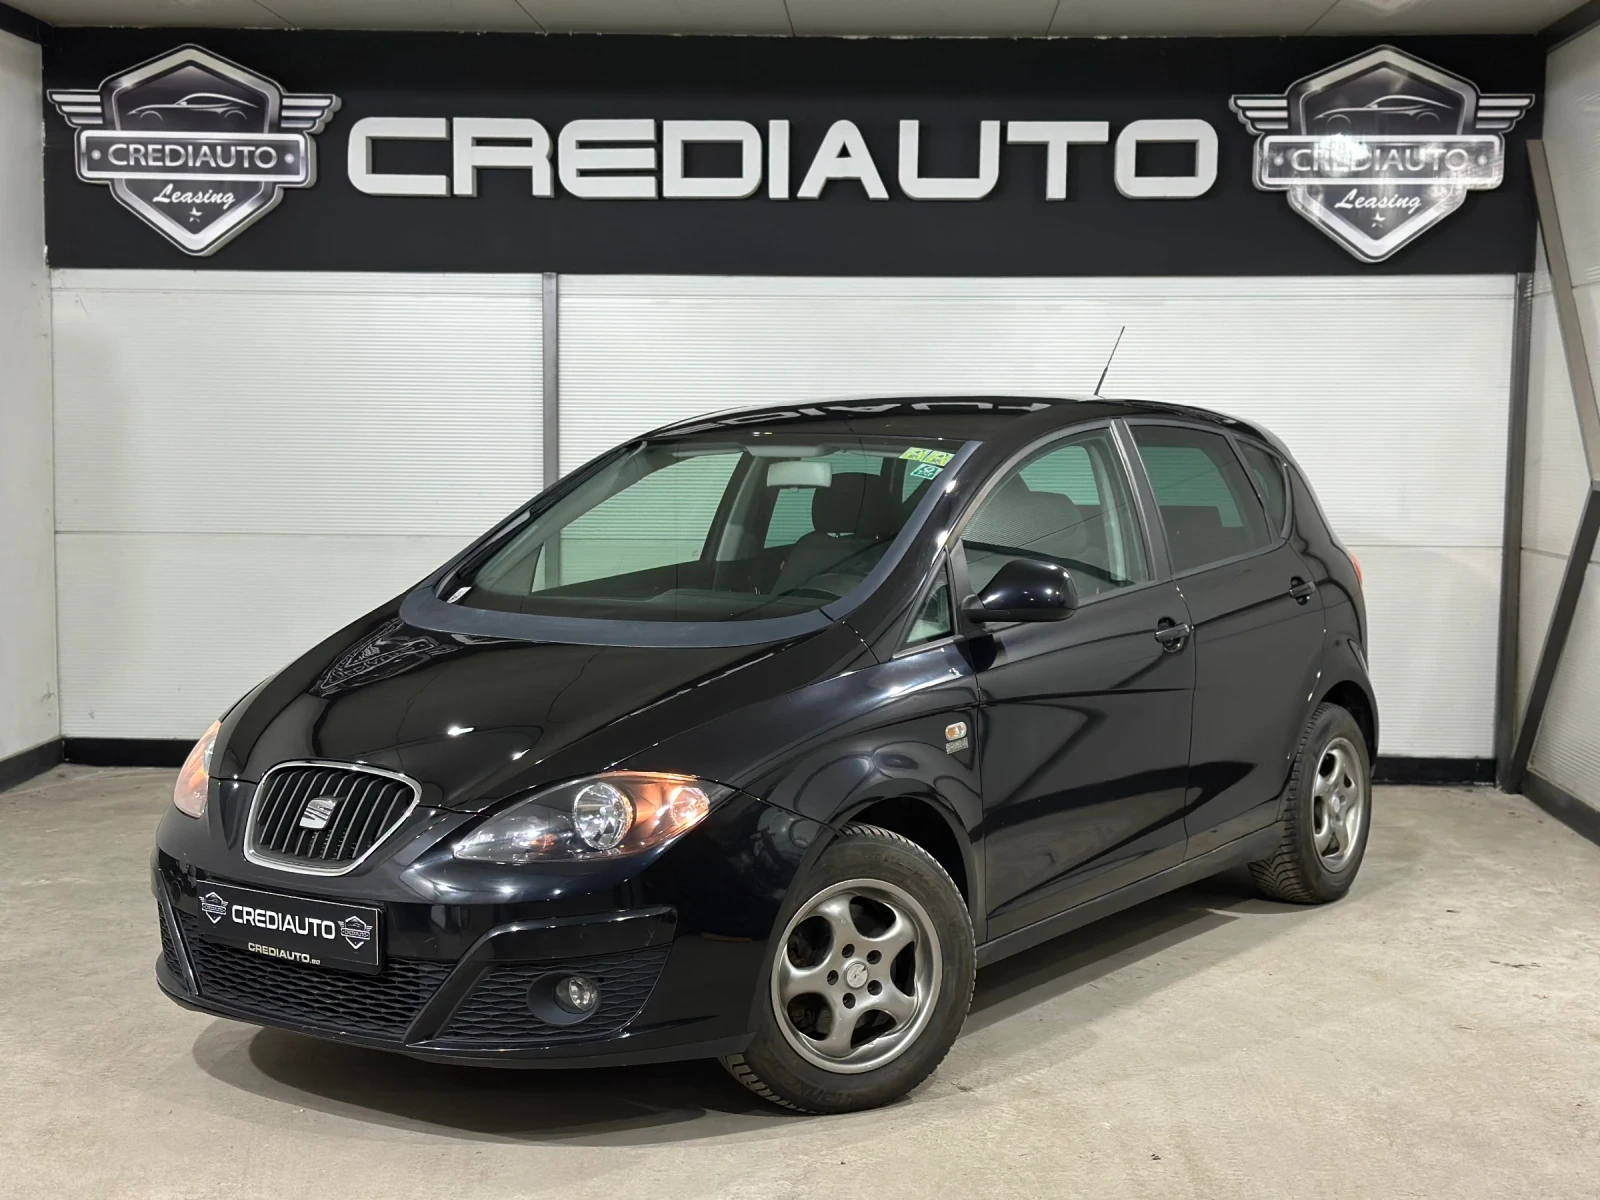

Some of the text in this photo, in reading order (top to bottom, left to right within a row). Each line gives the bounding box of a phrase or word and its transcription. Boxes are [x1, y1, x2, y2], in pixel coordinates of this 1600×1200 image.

[107, 143, 278, 169] CREDIAUTO
[347, 117, 1219, 201] CREDIAUTO
[152, 183, 236, 209] Leasing
[1334, 188, 1422, 215] Leasing
[231, 904, 336, 940] CREDIAUTO
